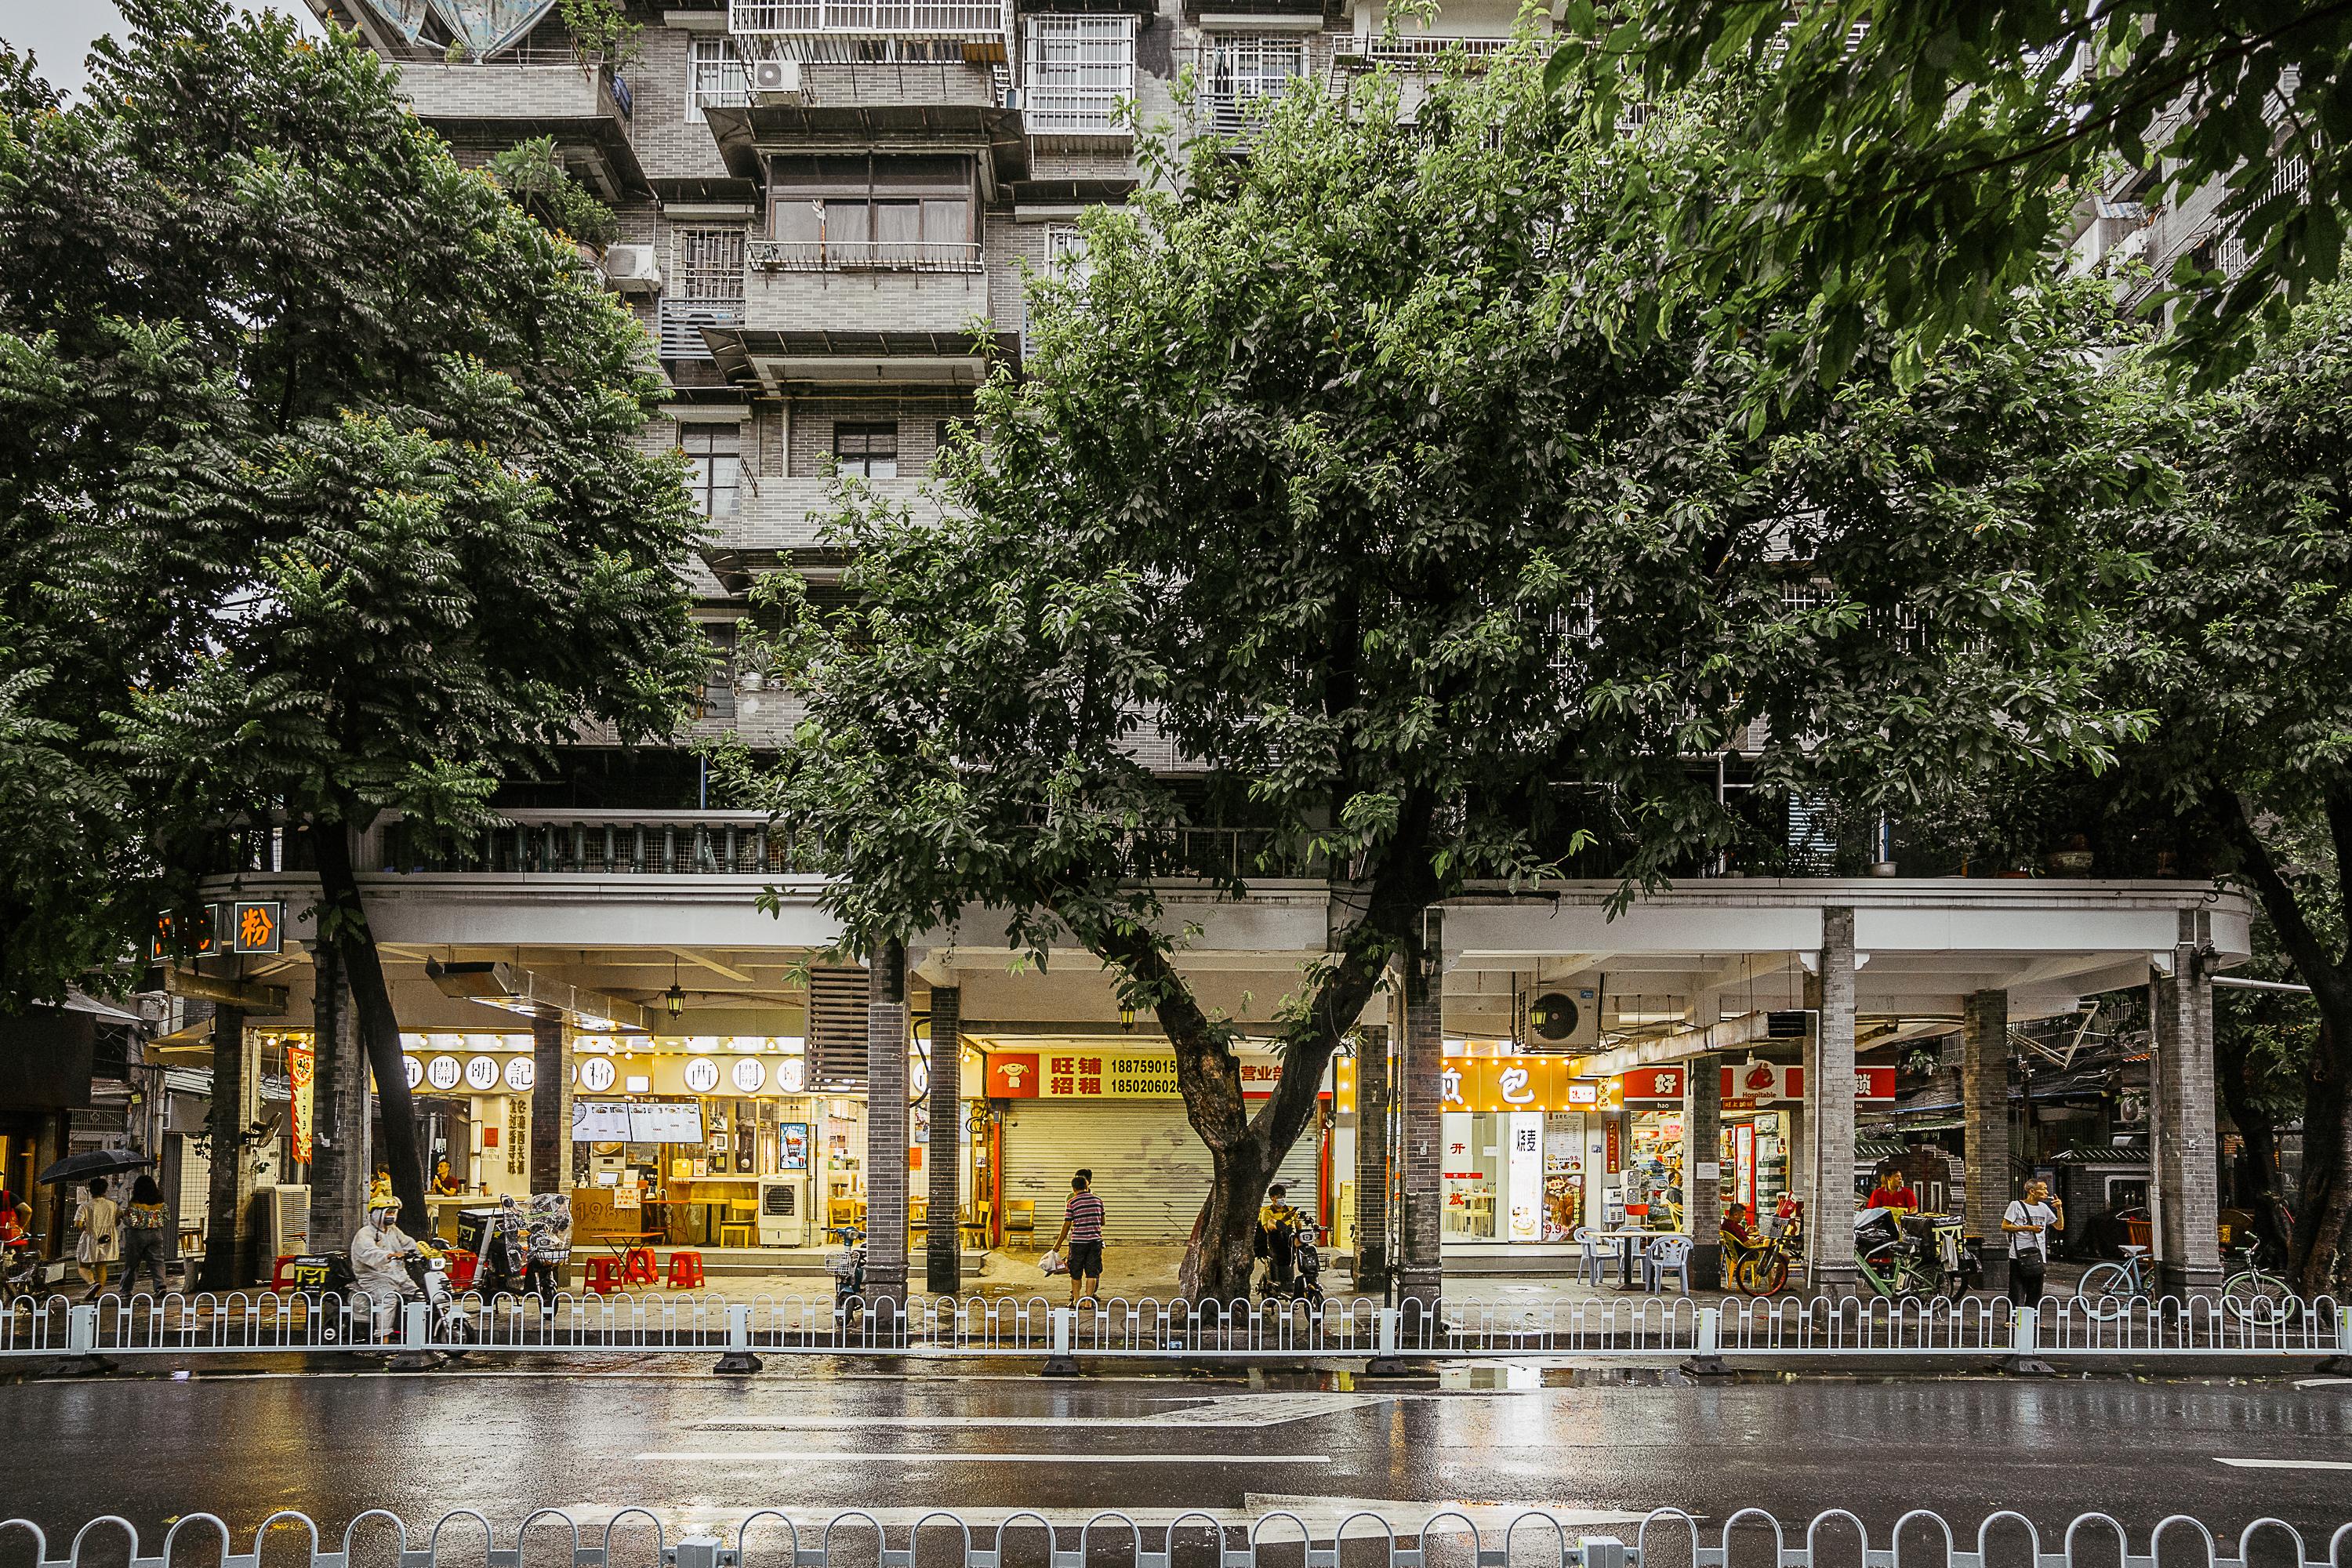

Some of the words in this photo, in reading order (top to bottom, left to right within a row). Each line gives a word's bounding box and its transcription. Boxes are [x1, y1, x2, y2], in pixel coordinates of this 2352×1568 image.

[241, 907, 274, 948] 粉
[1051, 1057, 1102, 1075] 旺铺
[1051, 1076, 1102, 1094] 招租
[1655, 1074, 1677, 1094] 好
[1450, 1143, 1465, 1154] 开
[1449, 1192, 1465, 1205] 放
